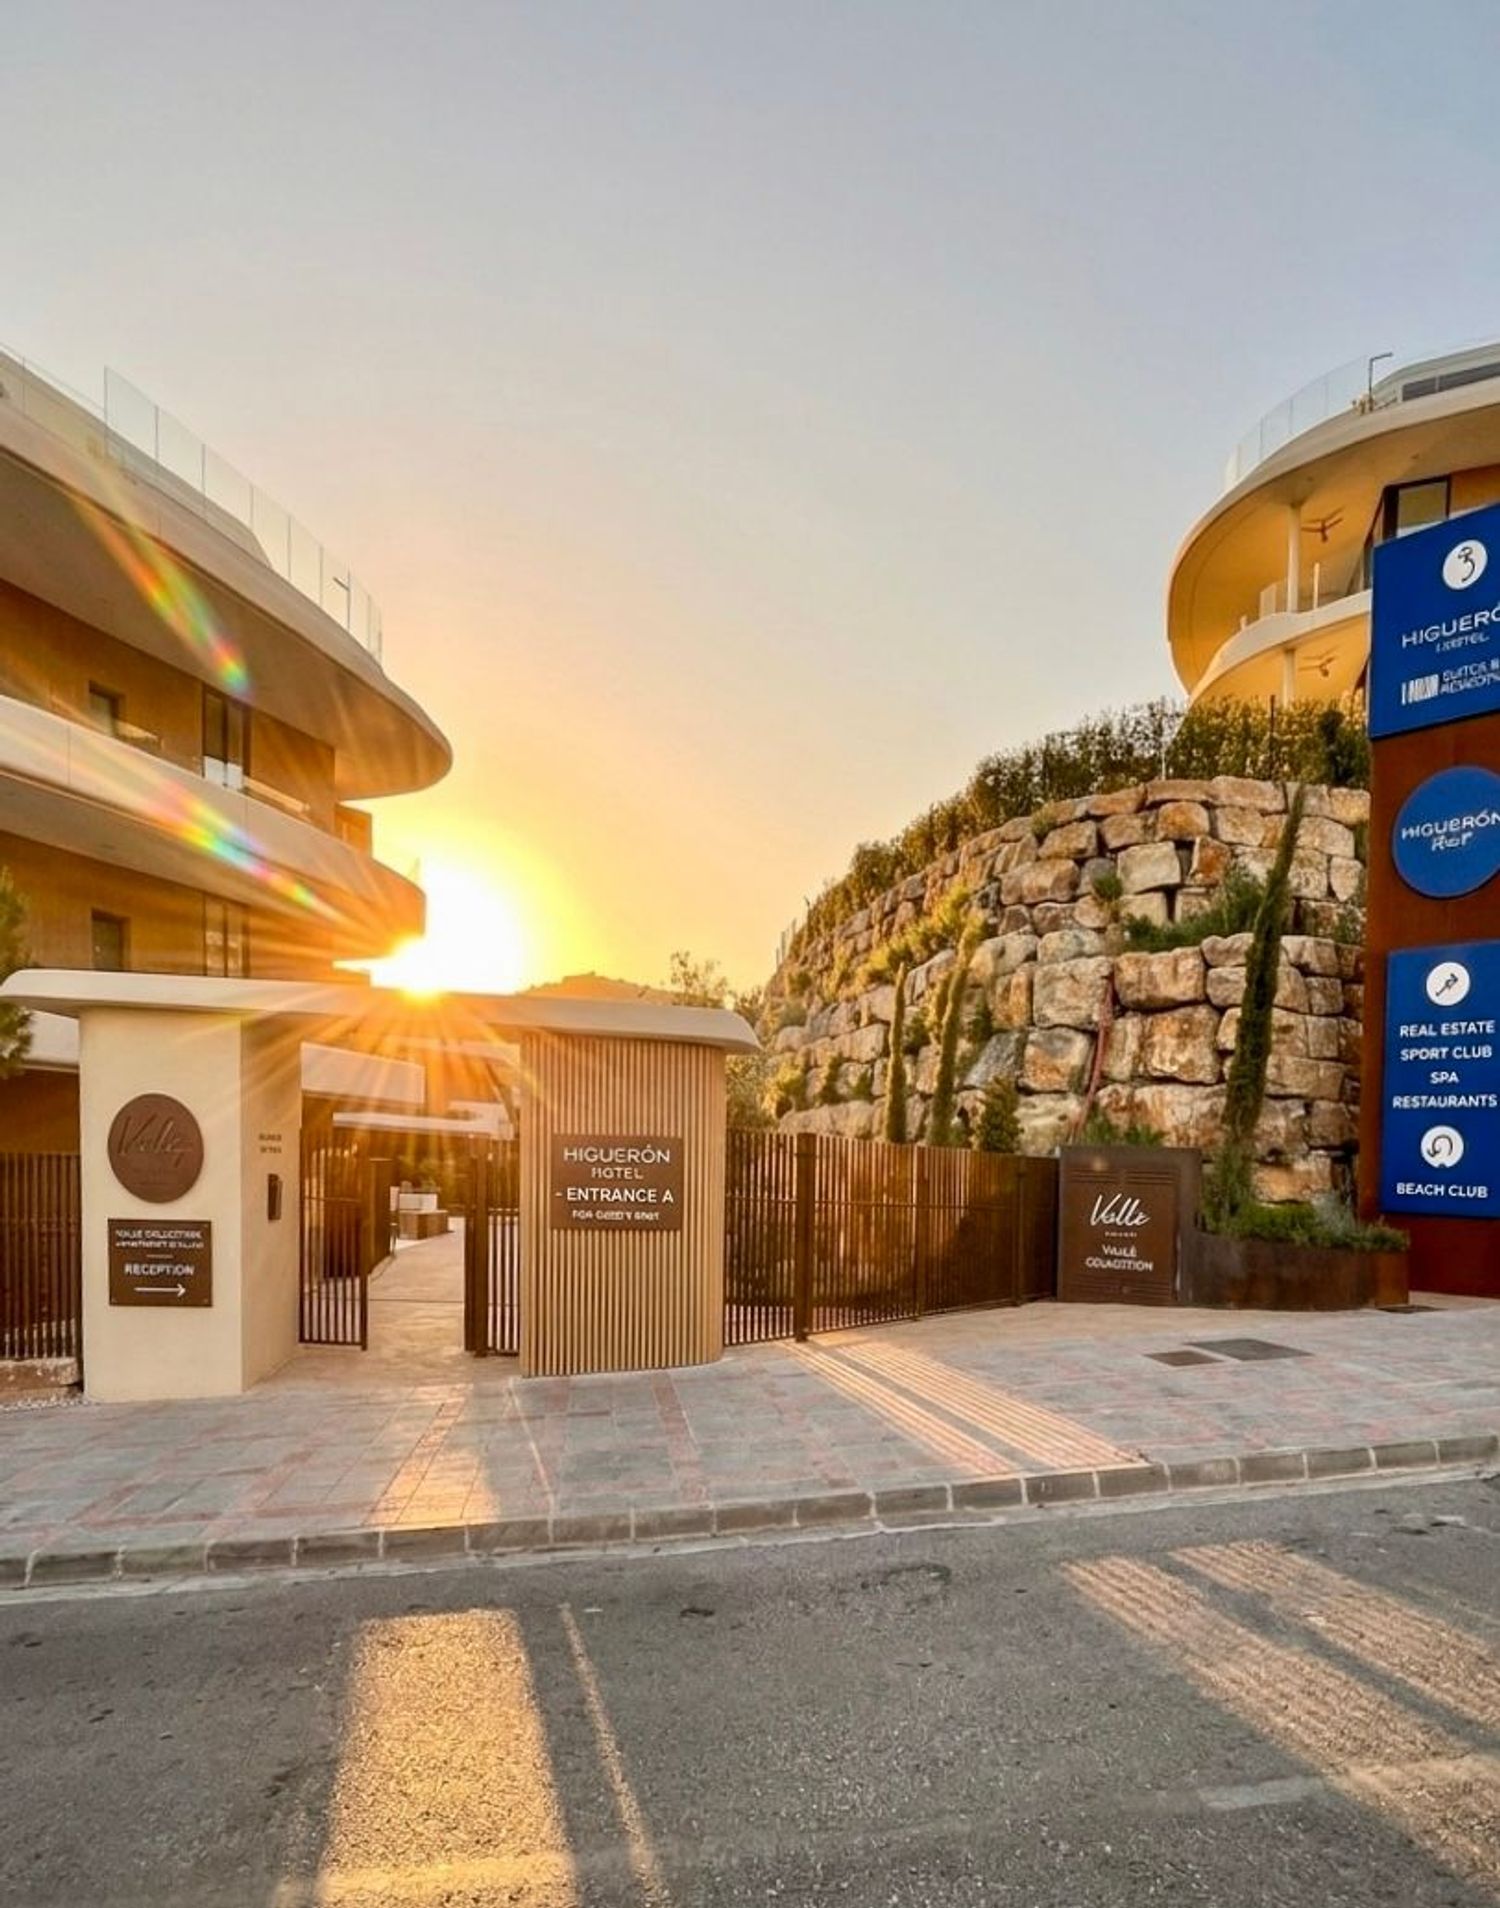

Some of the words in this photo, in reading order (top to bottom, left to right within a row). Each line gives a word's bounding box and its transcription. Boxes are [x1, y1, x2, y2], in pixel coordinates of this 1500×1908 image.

[1400, 1023, 1437, 1038] REAL
[1441, 1020, 1496, 1036] ESTATE
[1400, 1047, 1449, 1061] SPORT
[1452, 1044, 1493, 1060] CLUB
[1430, 1071, 1459, 1084] SPA
[1392, 1094, 1498, 1109] RESTAURANTS
[563, 1144, 670, 1163] HIGUERÓN
[567, 1187, 657, 1203] ENTRANCE
[662, 1189, 674, 1203] A
[1396, 1182, 1445, 1197] BEACH
[1448, 1184, 1488, 1199] CLUB
[125, 1263, 195, 1276] RECEPTION
